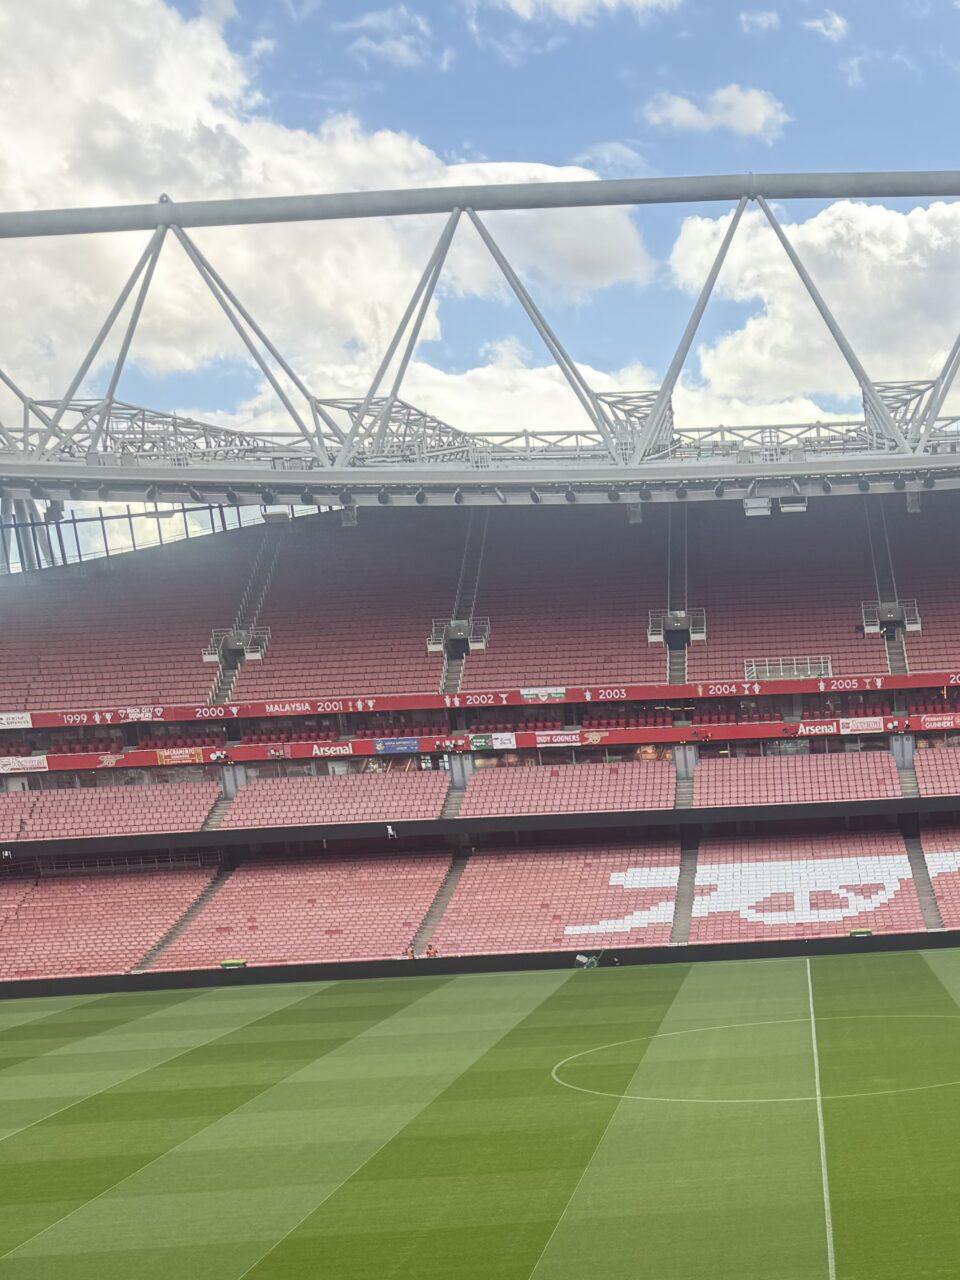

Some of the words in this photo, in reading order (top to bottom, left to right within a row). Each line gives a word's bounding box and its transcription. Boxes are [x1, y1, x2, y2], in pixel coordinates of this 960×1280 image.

[709, 685, 736, 694] 2004
[831, 679, 858, 690] 2005
[466, 694, 494, 704] 2002
[599, 690, 626, 698] 2003
[266, 702, 310, 712] MALAYSIA
[318, 702, 342, 712] 2001
[196, 708, 224, 718] 2000
[64, 714, 88, 724] 1999
[798, 722, 836, 734] Arsenal
[312, 744, 352, 756] Arsenal
